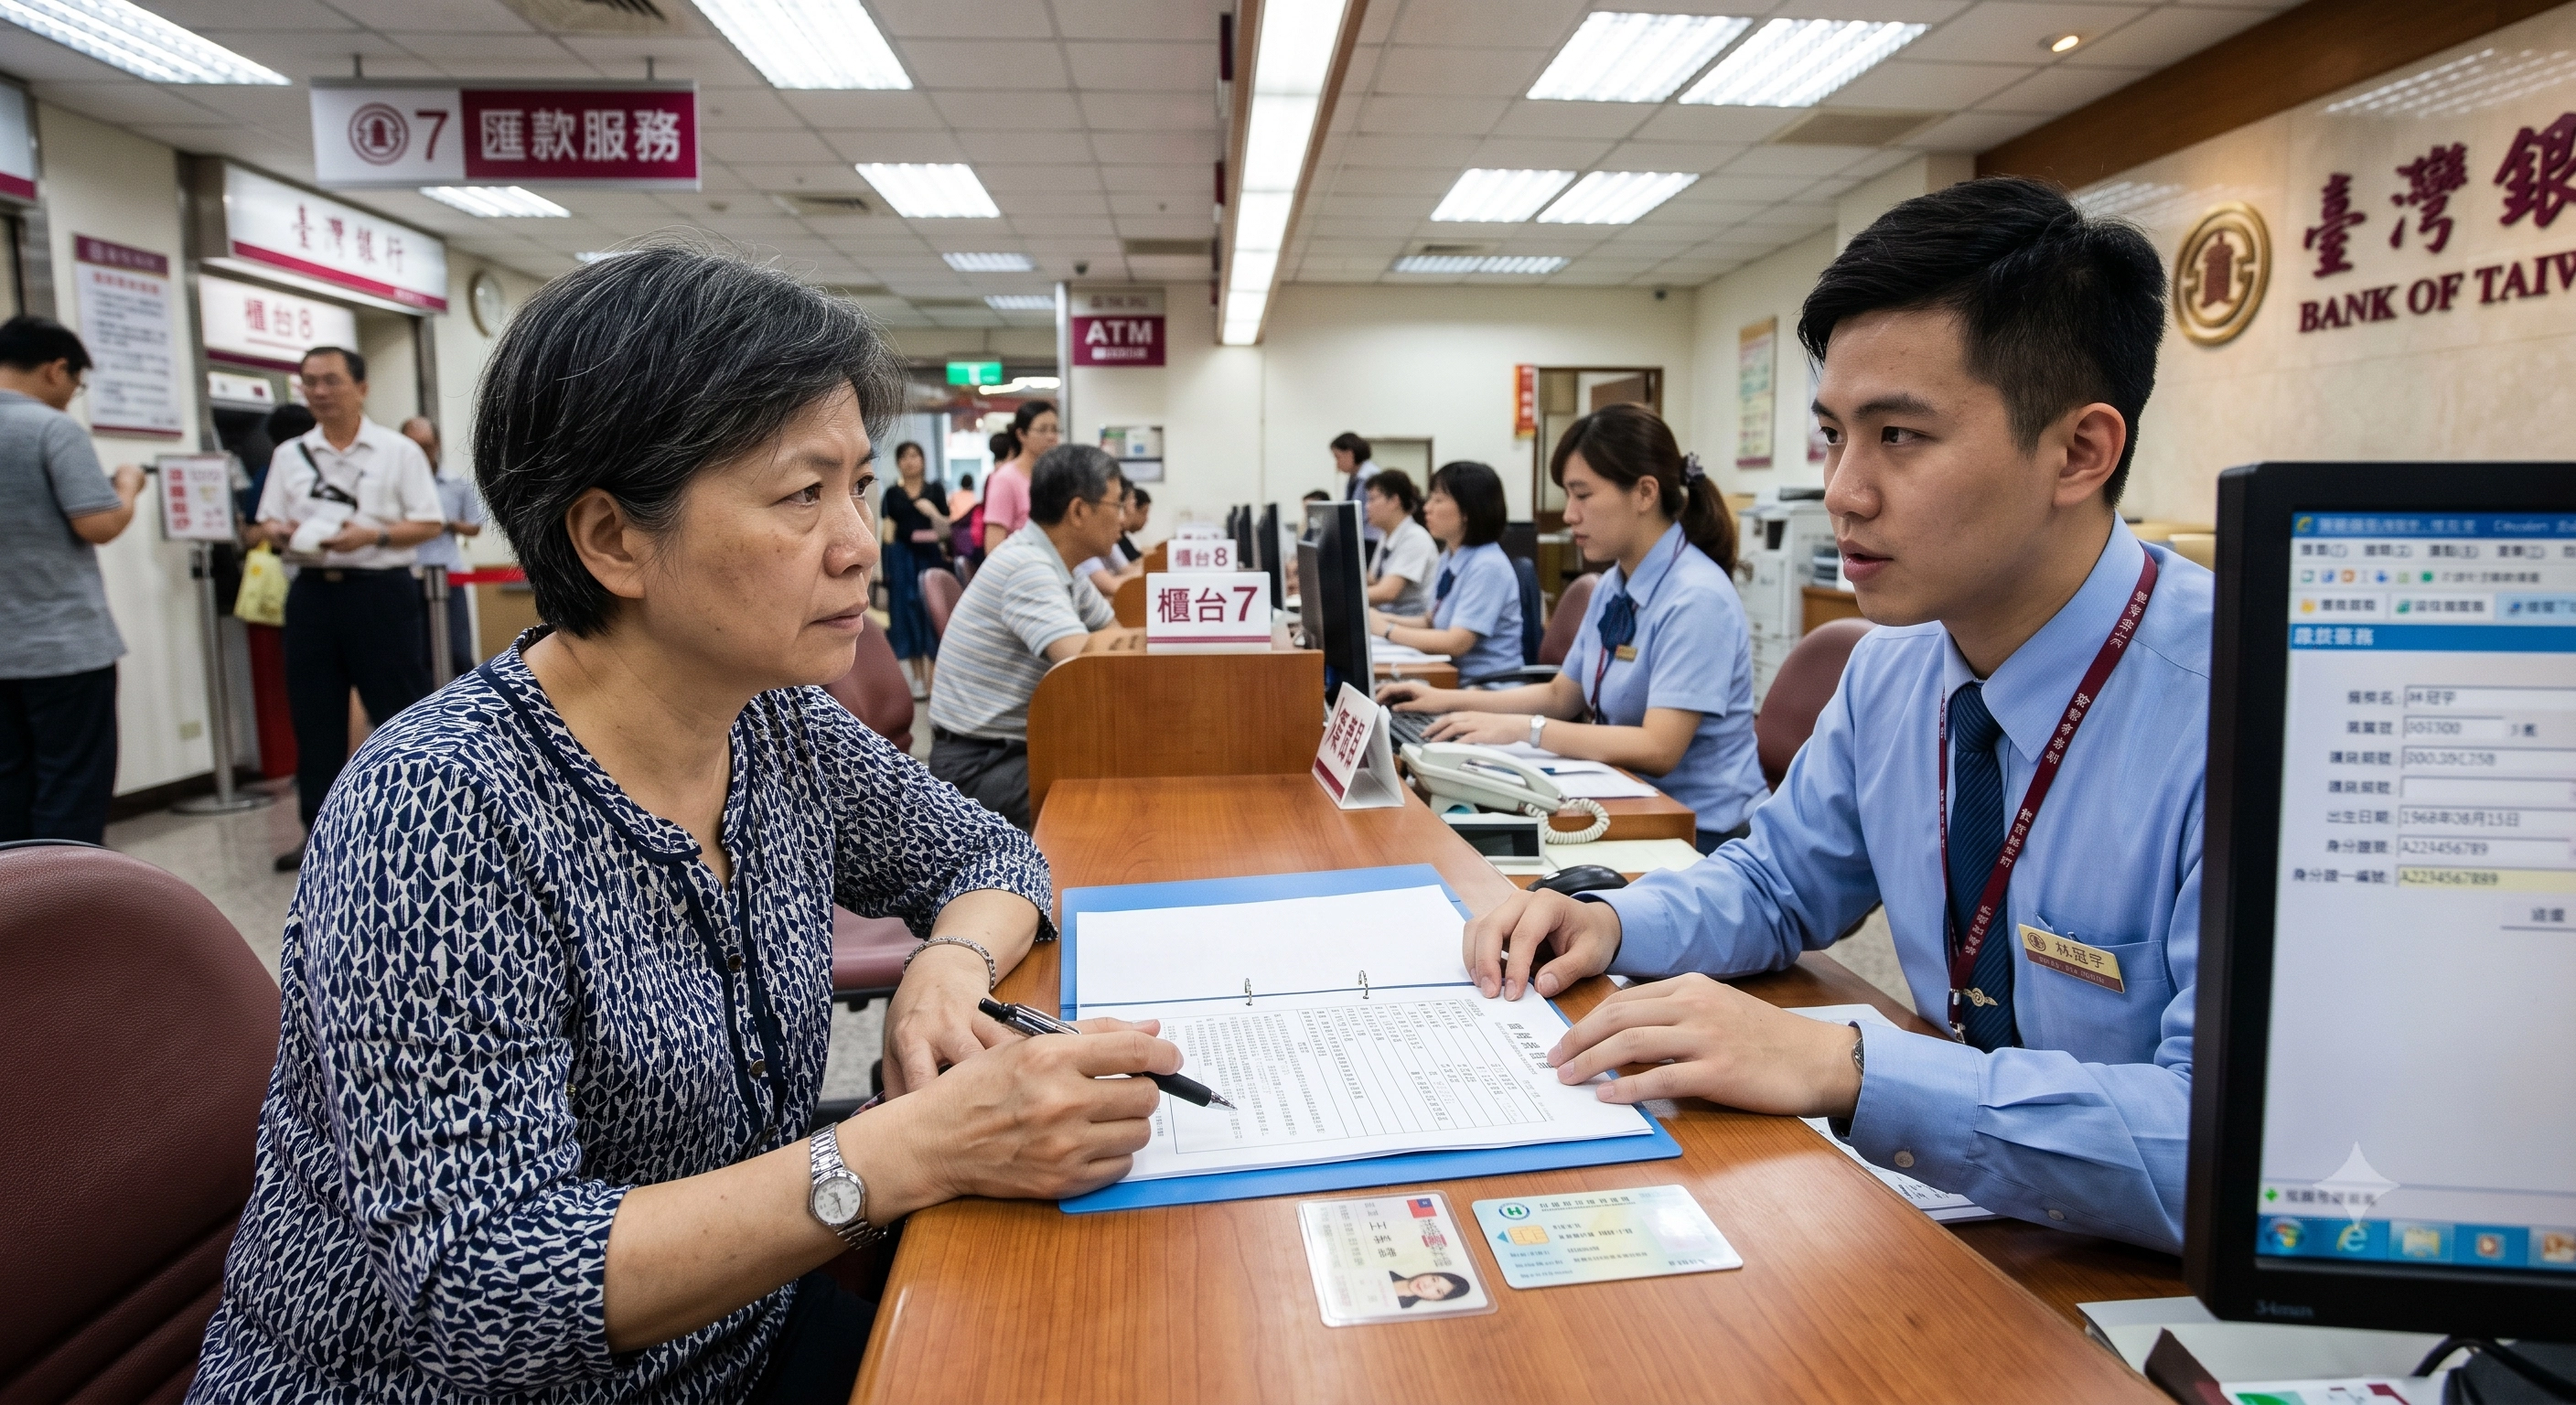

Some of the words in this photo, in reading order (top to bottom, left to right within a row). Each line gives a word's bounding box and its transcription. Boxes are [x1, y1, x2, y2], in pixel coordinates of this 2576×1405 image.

[415, 110, 450, 162] 7
[479, 108, 682, 163] 匯款服務
[2303, 113, 2576, 279] 臺灣銀
[2299, 284, 2399, 334] BANK
[2407, 273, 2464, 316] OF
[1085, 320, 1153, 346] ATM
[1157, 586, 1258, 623] 櫃台7
